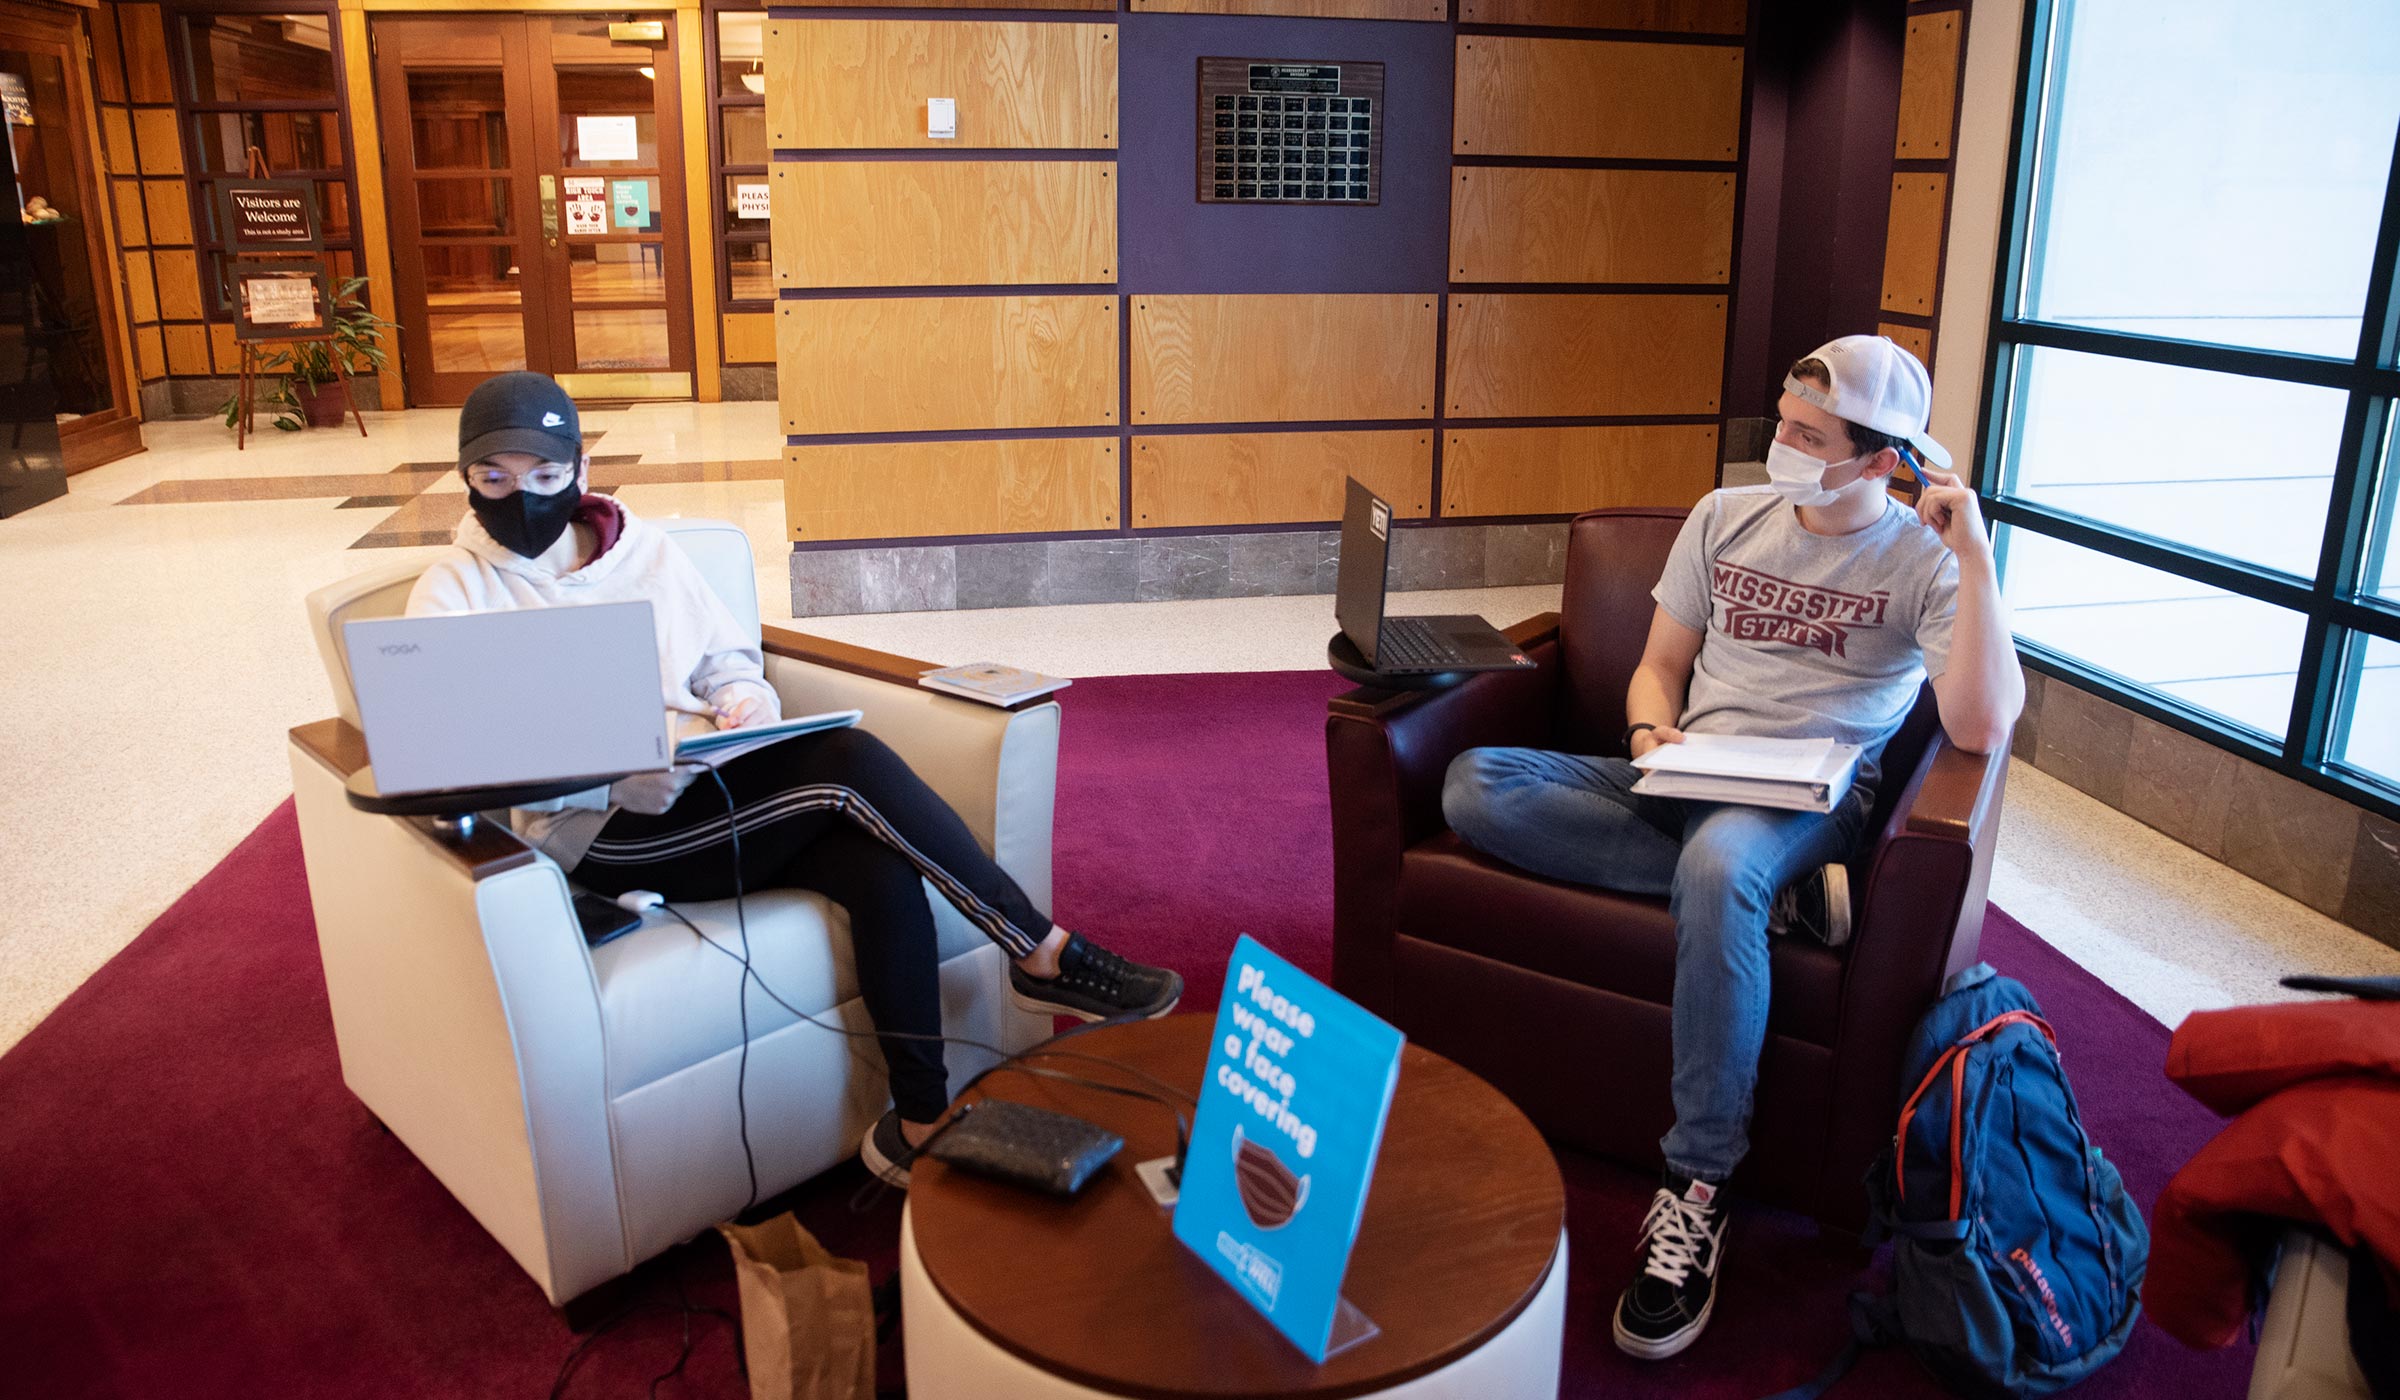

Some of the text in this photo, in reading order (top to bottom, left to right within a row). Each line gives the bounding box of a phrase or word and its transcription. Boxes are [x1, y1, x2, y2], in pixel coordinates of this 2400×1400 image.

[236, 196, 301, 208] Visitors are
[245, 210, 298, 222] Welcome
[276, 228, 291, 236] study
[378, 644, 422, 656] YOGA
[1741, 617, 1823, 647] STATE
[1237, 963, 1316, 1038] Please
[1232, 1002, 1295, 1058] wear
[1224, 1034, 1296, 1098] a face
[1218, 1064, 1318, 1159] covering
[2010, 1248, 2072, 1348] patagonia
